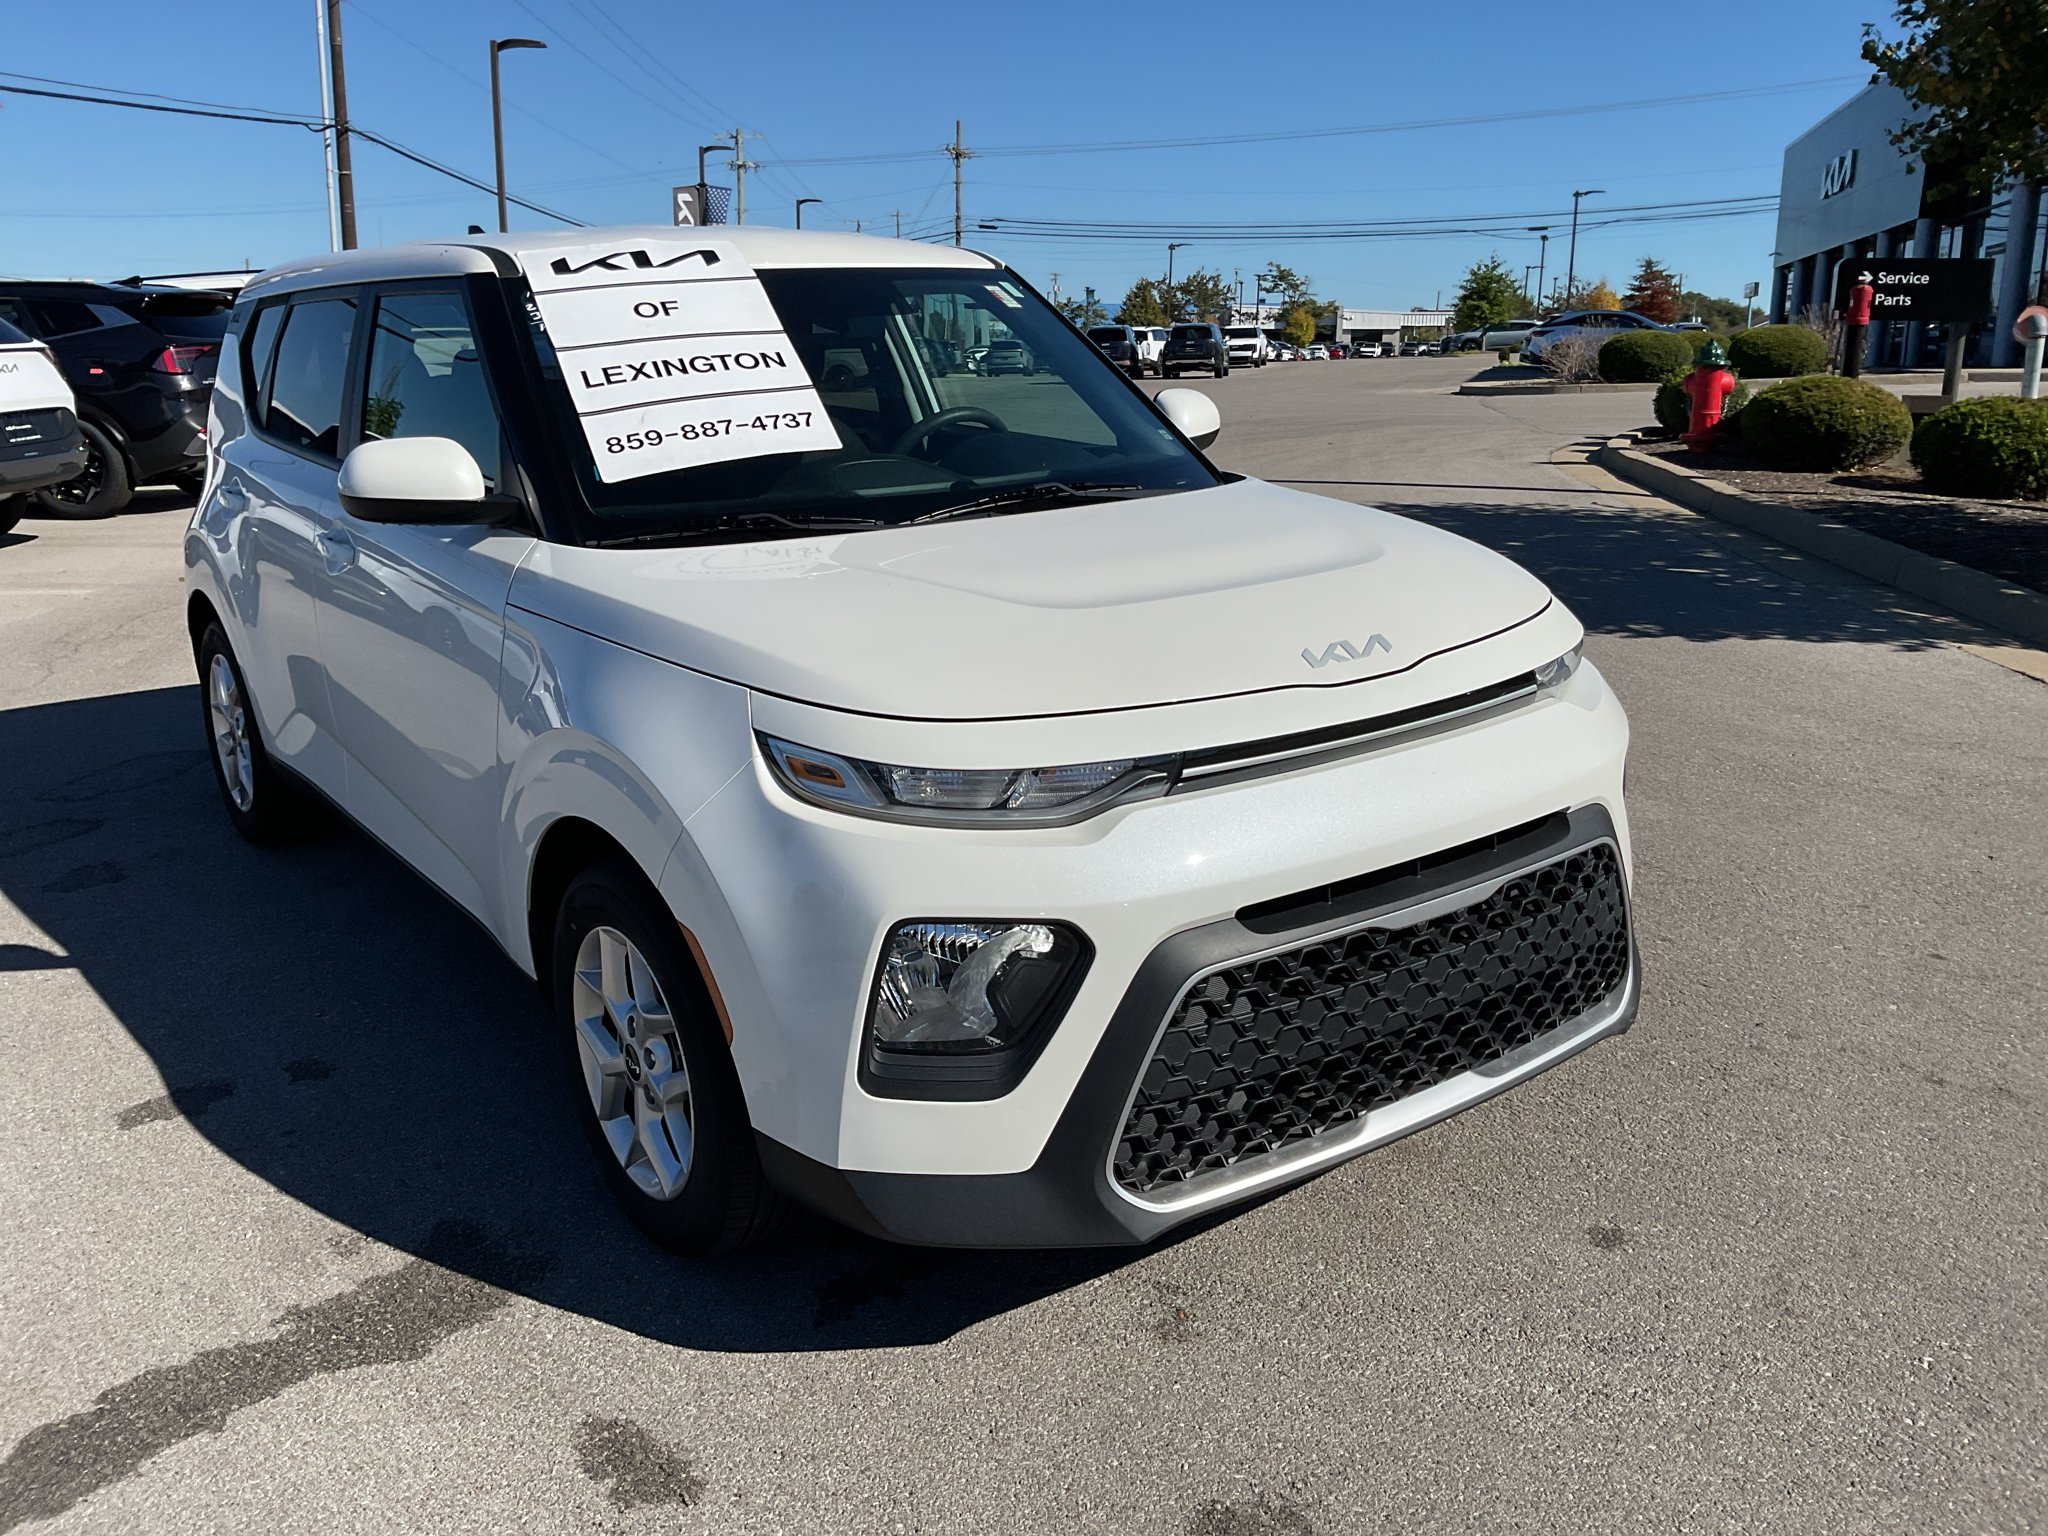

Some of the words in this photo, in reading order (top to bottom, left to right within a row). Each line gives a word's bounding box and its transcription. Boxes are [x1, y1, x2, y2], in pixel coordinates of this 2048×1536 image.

[1820, 149, 1858, 200] KIA
[550, 249, 721, 275] KIA
[1877, 271, 1930, 284] Service
[633, 300, 679, 318] OF
[1875, 293, 1912, 306] Parts
[580, 351, 787, 389] LEXINGTON
[605, 411, 813, 454] 859-887-4737
[1301, 633, 1393, 669] KIA
